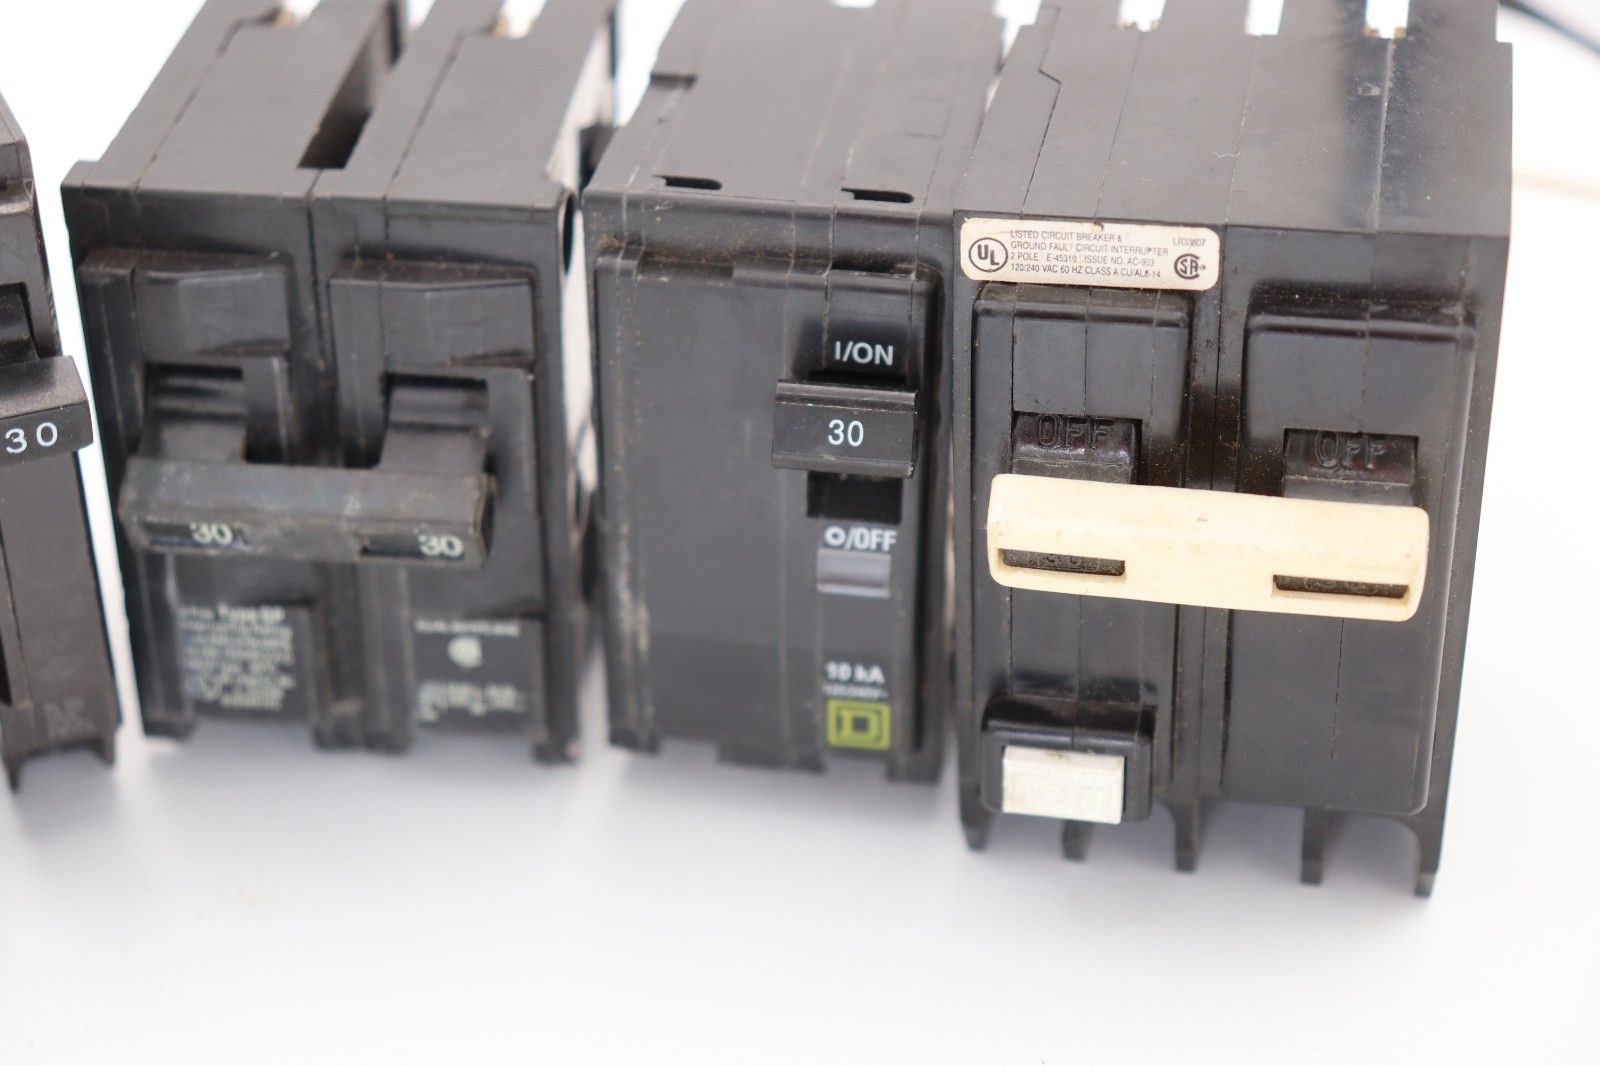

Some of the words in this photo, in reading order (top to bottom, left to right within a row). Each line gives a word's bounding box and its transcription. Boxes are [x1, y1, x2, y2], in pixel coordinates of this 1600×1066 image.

[1010, 230, 1039, 239] LISTED
[1041, 231, 1074, 240] CIRCUIT
[1076, 232, 1115, 242] BREAKER
[1010, 240, 1047, 250] GROUND
[1075, 243, 1108, 253] CIRCUIT
[1111, 245, 1169, 256] INTERRUPTER
[1010, 252, 1015, 260] 2
[1017, 252, 1039, 261] POLE
[1084, 254, 1108, 264] ISSUE
[1127, 257, 1155, 267] AC-903
[1011, 263, 1040, 272] 120/240
[1042, 264, 1058, 273] VAC
[1060, 265, 1070, 274] 60
[1071, 265, 1083, 274] HZ
[1085, 266, 1111, 276] CLASS
[1113, 267, 1119, 276] A
[834, 340, 895, 367] I/ON
[5, 421, 59, 455] 30
[827, 418, 865, 447] 30
[1036, 413, 1116, 450] OFF
[1313, 430, 1387, 470] OFF
[190, 522, 234, 545] 30
[418, 533, 464, 559] 30
